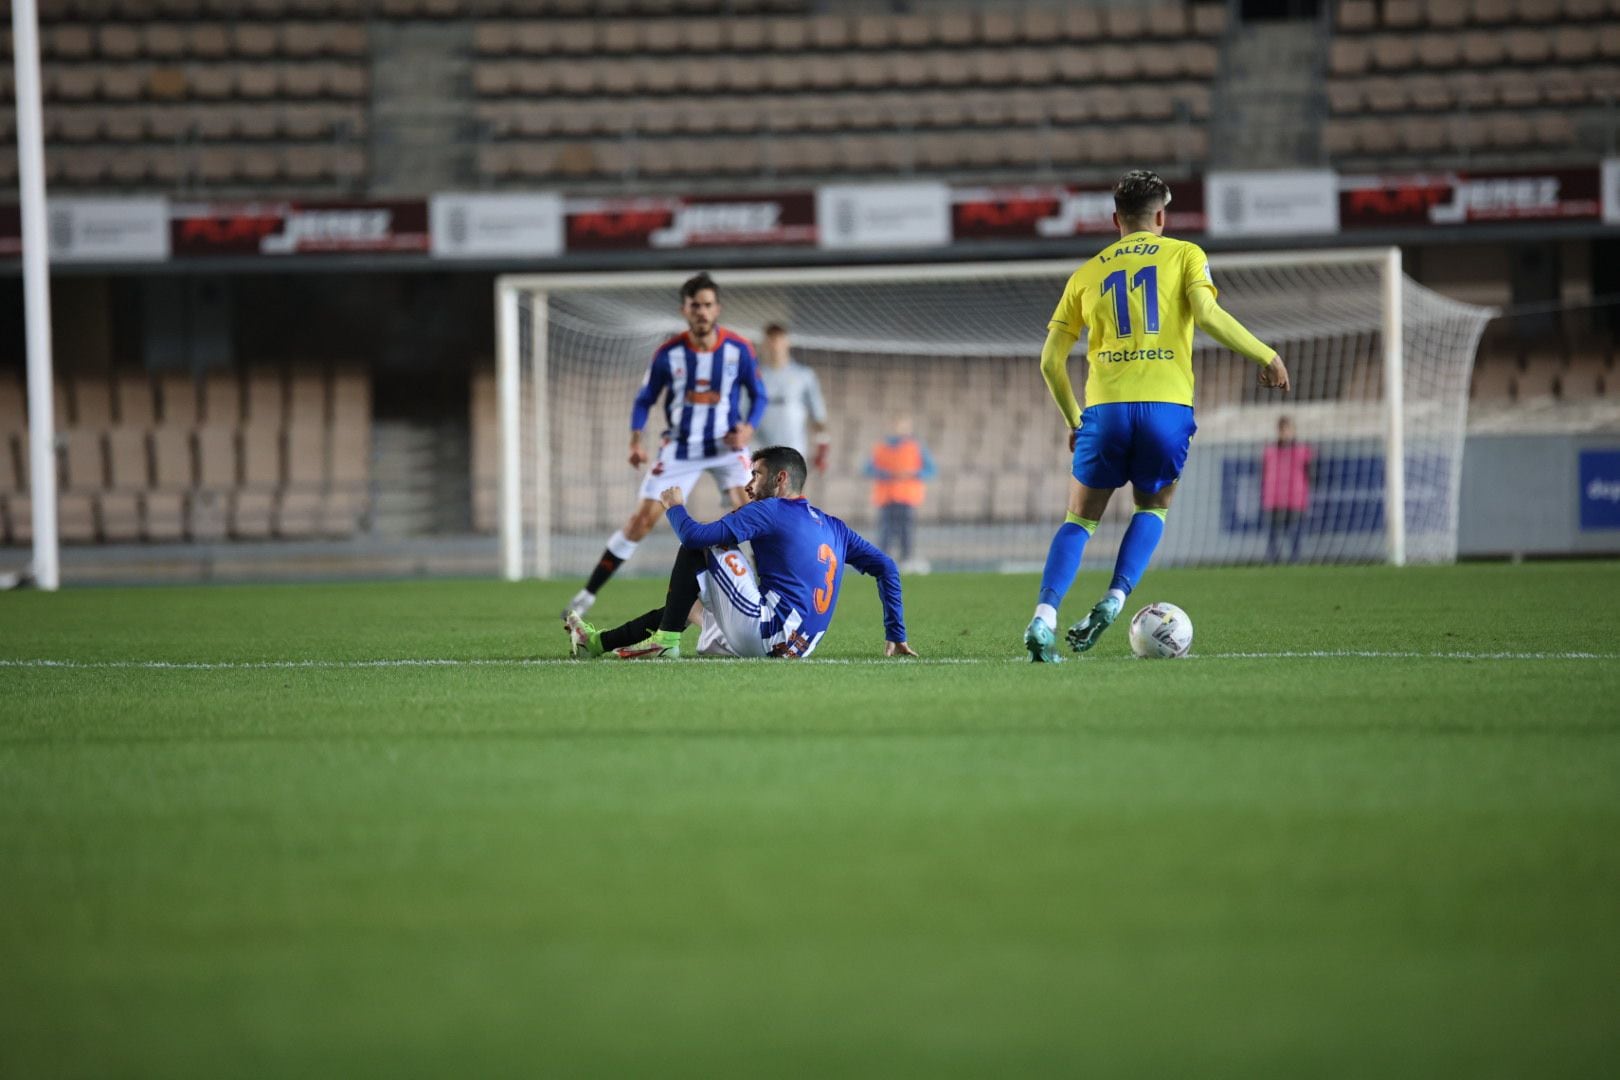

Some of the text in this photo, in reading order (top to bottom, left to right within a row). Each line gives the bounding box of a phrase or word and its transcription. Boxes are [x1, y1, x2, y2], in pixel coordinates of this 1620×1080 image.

[1114, 243, 1159, 258] ALEJO
[1100, 265, 1159, 339] 11
[1098, 348, 1174, 363] motoreto
[724, 553, 746, 577] 3
[813, 543, 838, 615] 3
